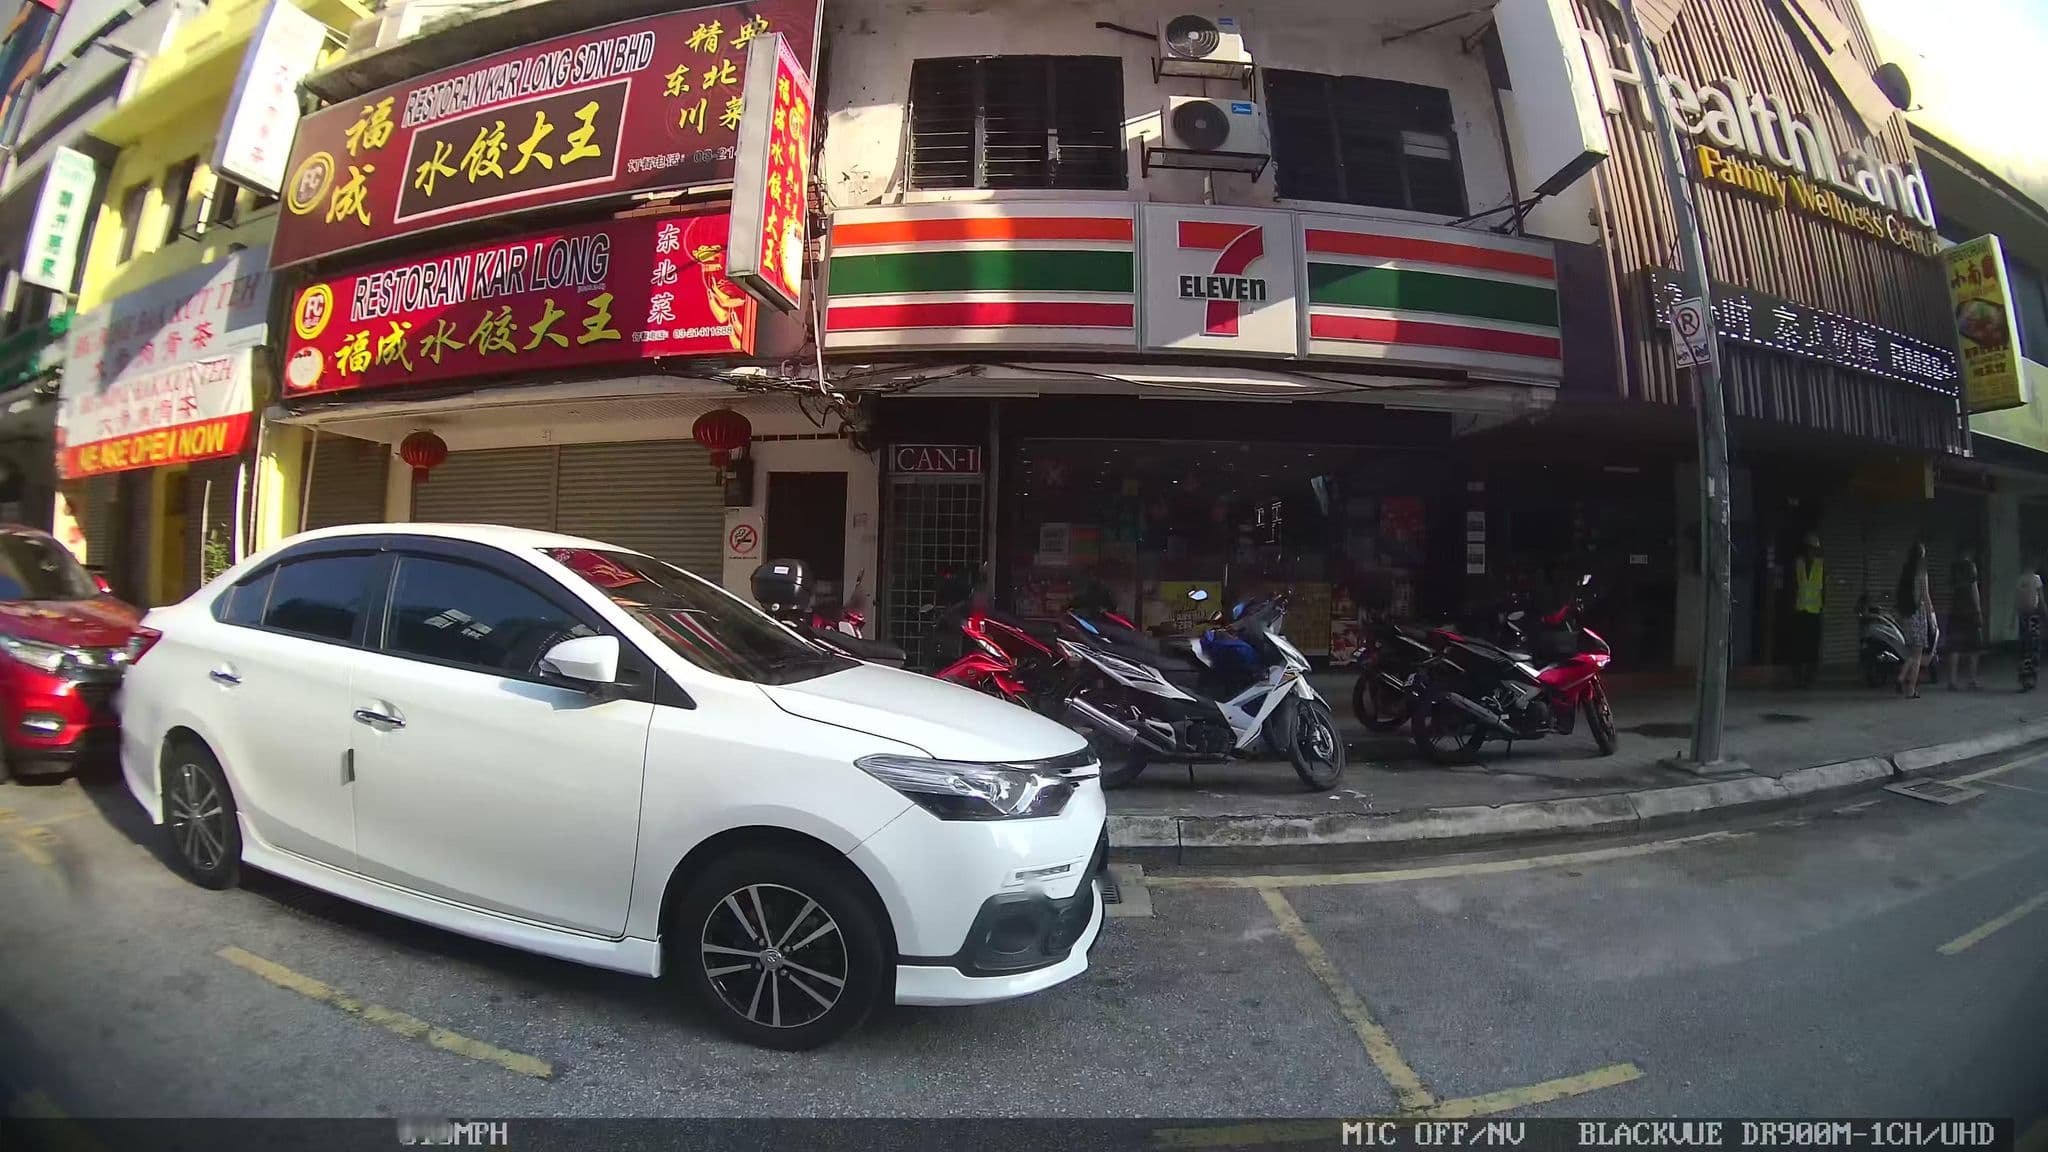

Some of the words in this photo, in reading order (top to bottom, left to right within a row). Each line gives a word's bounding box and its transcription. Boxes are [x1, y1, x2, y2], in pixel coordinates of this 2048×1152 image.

[401, 70, 485, 129] RESTORAN
[483, 60, 522, 105] KAR
[520, 48, 574, 93] LONG
[571, 38, 616, 84] SDN
[611, 30, 656, 77] BHD
[663, 58, 738, 97] 东北
[326, 96, 395, 227] 福成
[414, 101, 602, 197] 水饺大王
[1696, 143, 1787, 209] Family
[1787, 173, 1885, 239] Wellness
[350, 254, 471, 323] RESTORAN
[471, 245, 529, 301] KAR
[530, 233, 610, 291] LONG
[647, 223, 680, 325] 东北菜
[1177, 220, 1264, 337] 7
[335, 292, 622, 377] 福成水饺大王
[179, 422, 228, 457] NOW
[897, 447, 976, 472] CAN-I
